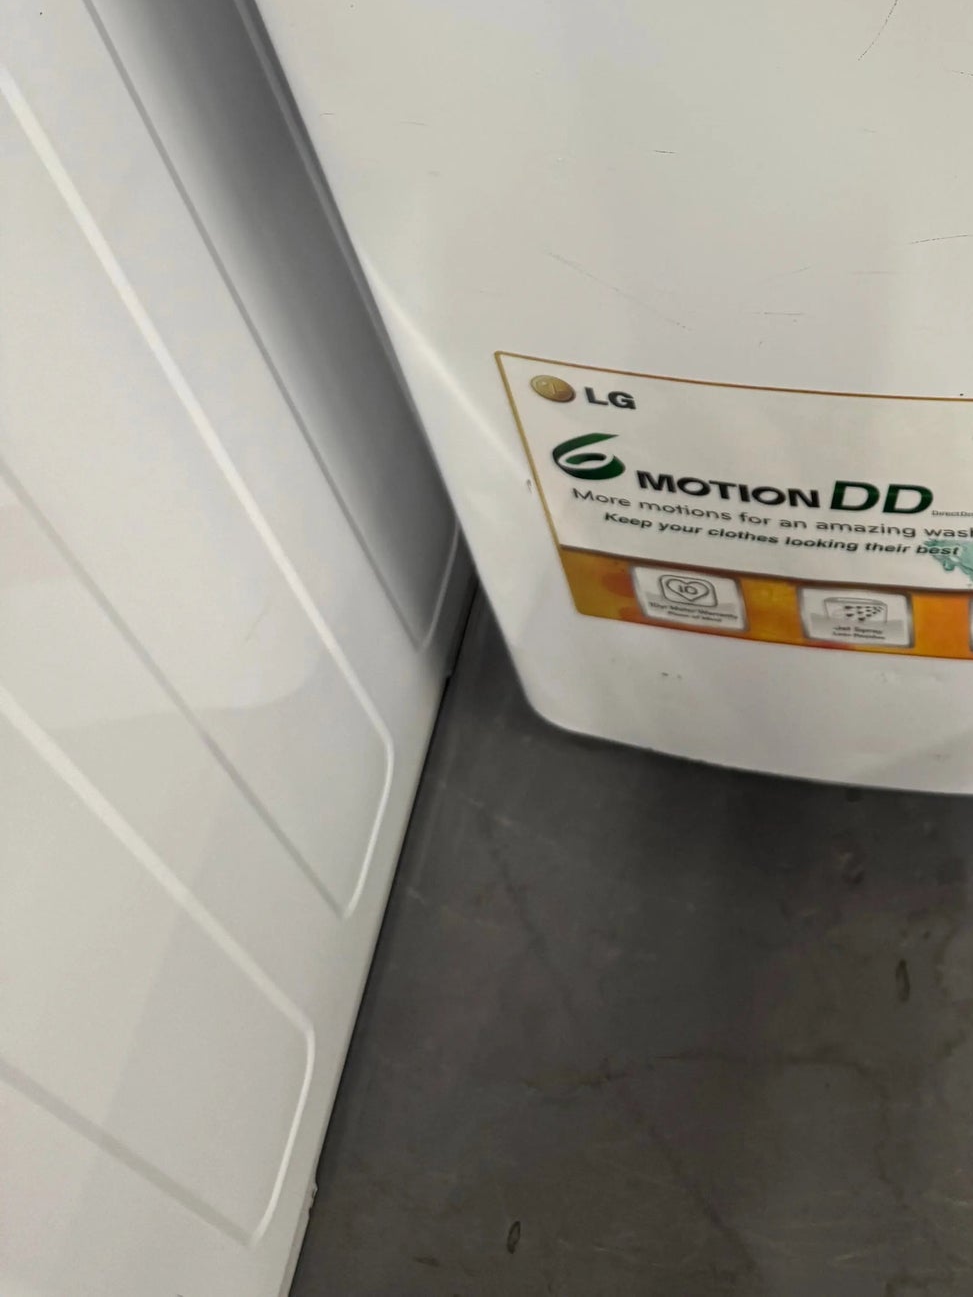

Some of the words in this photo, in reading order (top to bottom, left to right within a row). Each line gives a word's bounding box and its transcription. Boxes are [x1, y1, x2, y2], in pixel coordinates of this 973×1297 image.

[584, 386, 637, 410] LG
[572, 487, 631, 507] More
[639, 501, 732, 521] motions
[739, 512, 771, 526] for
[780, 518, 808, 529] an
[816, 520, 916, 538] amazing
[636, 470, 821, 509] MOTION
[830, 480, 934, 515] DD
[604, 512, 653, 529] Keep
[658, 521, 703, 534] your
[708, 527, 779, 544] clothes
[785, 536, 858, 552] looking
[865, 542, 911, 554] their
[916, 544, 961, 556] best
